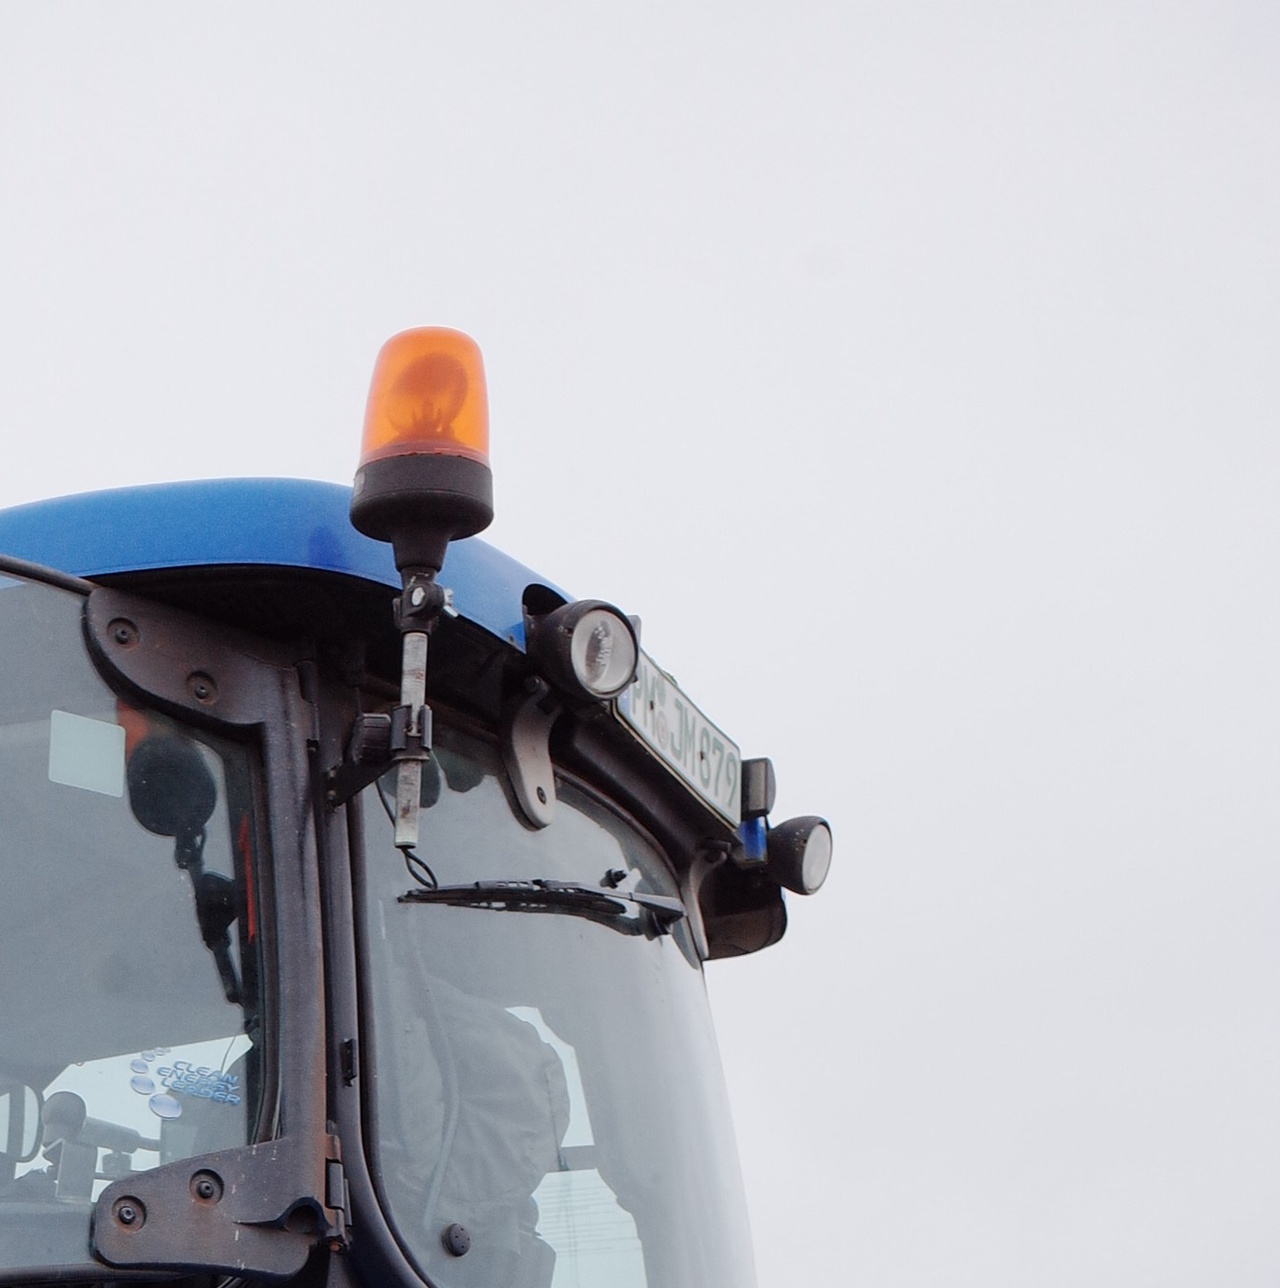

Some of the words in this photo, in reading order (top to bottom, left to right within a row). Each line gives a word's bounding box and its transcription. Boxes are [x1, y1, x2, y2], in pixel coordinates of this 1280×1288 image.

[699, 727, 738, 808] 879
[157, 1066, 240, 1093] ENERGY
[173, 1060, 239, 1085] CLEAN
[161, 1077, 242, 1106] LEADER
